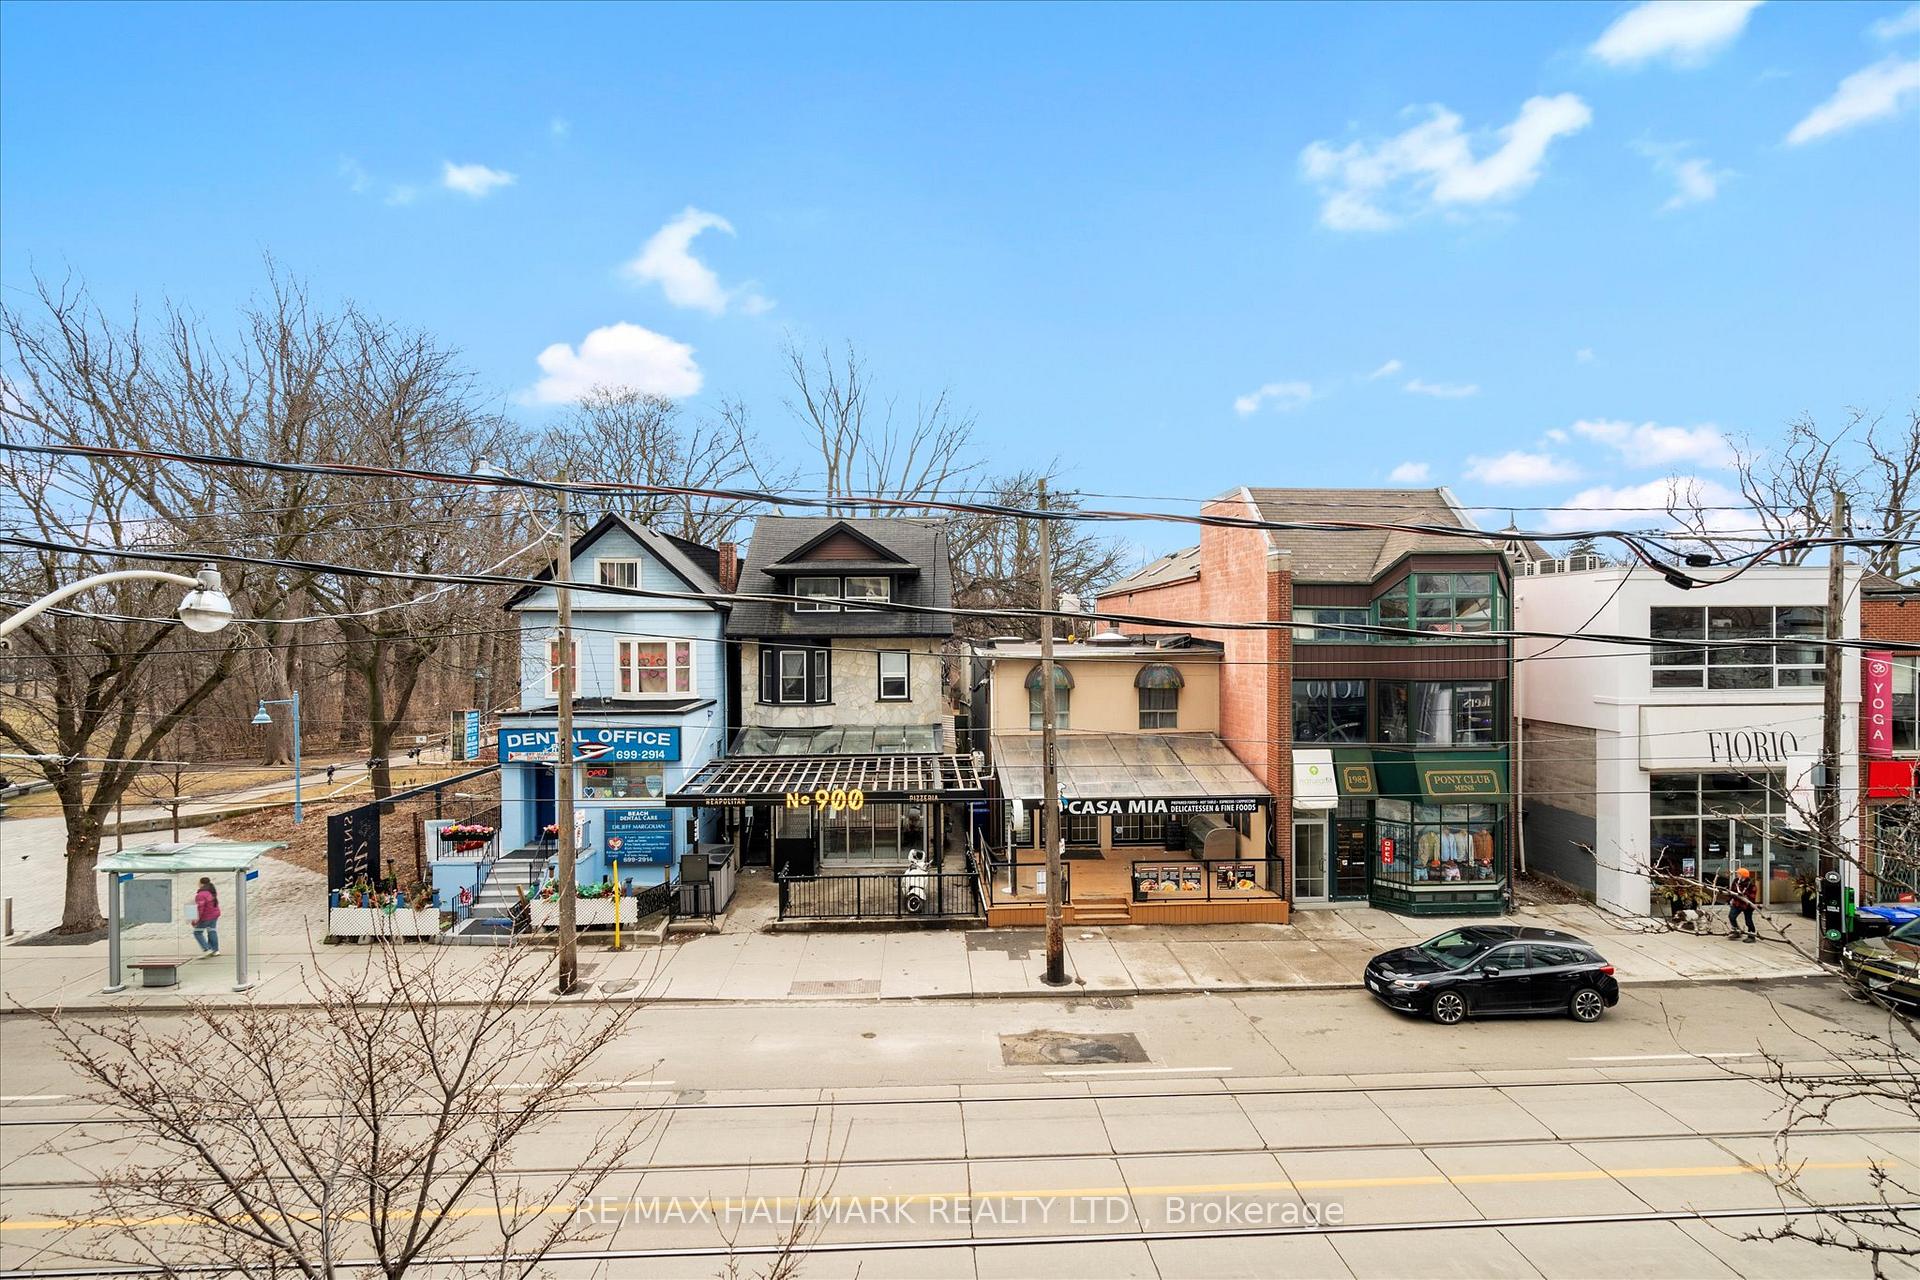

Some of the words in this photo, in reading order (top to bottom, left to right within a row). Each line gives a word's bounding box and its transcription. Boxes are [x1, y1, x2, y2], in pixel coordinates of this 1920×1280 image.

[1872, 682, 1885, 741] YOGA
[597, 729, 672, 746] OFFICE
[616, 749, 665, 760] 699-2914
[587, 768, 608, 778] OPEN
[1433, 775, 1462, 784] PONY
[1463, 774, 1491, 784] CLUB
[1454, 784, 1475, 792] MENS
[705, 797, 746, 805] NEAPOLITAN
[815, 789, 864, 811] 900
[909, 794, 939, 802] PIZZERIA
[1068, 800, 1123, 815] CASA
[1128, 799, 1169, 814] MIA
[1170, 804, 1214, 813] DELICATESSEN
[1214, 804, 1220, 812] &
[1221, 804, 1234, 812] FINE
[1235, 803, 1256, 811] FOODS
